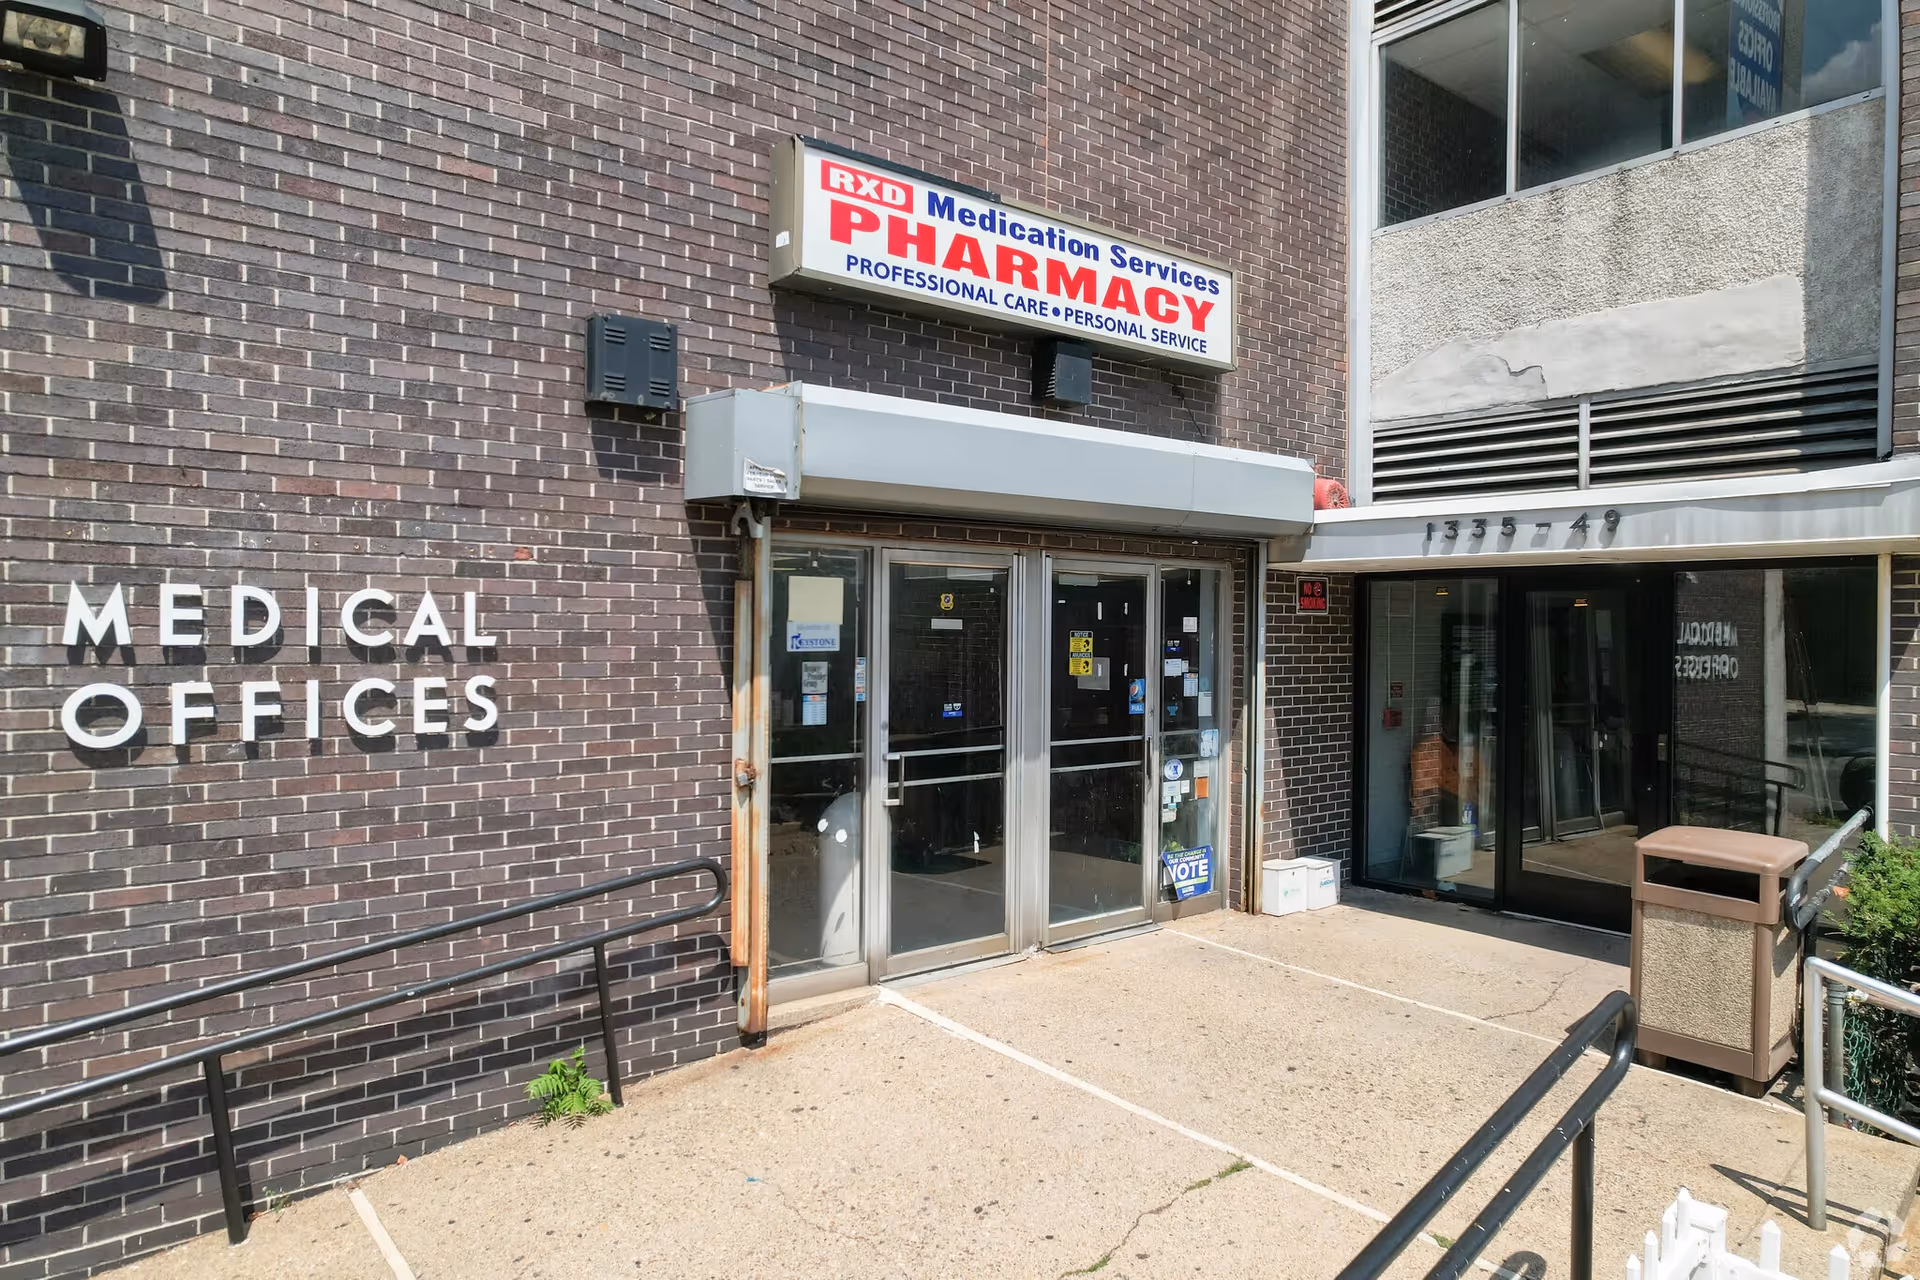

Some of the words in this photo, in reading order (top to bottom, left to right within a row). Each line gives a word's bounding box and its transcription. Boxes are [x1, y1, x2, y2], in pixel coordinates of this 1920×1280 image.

[828, 165, 907, 208] RXD
[829, 199, 1216, 332] PHARMACY
[927, 191, 1100, 262] Medication
[1110, 244, 1220, 296] Services
[846, 254, 998, 306] PROFESSIONAL
[1003, 293, 1049, 317] CARE
[1064, 307, 1147, 340] PERSONAL
[1151, 327, 1207, 354] SERVICE
[62, 579, 498, 647] MEDICAL
[60, 674, 499, 750] OFFICES
[1167, 859, 1208, 882] VOTE
